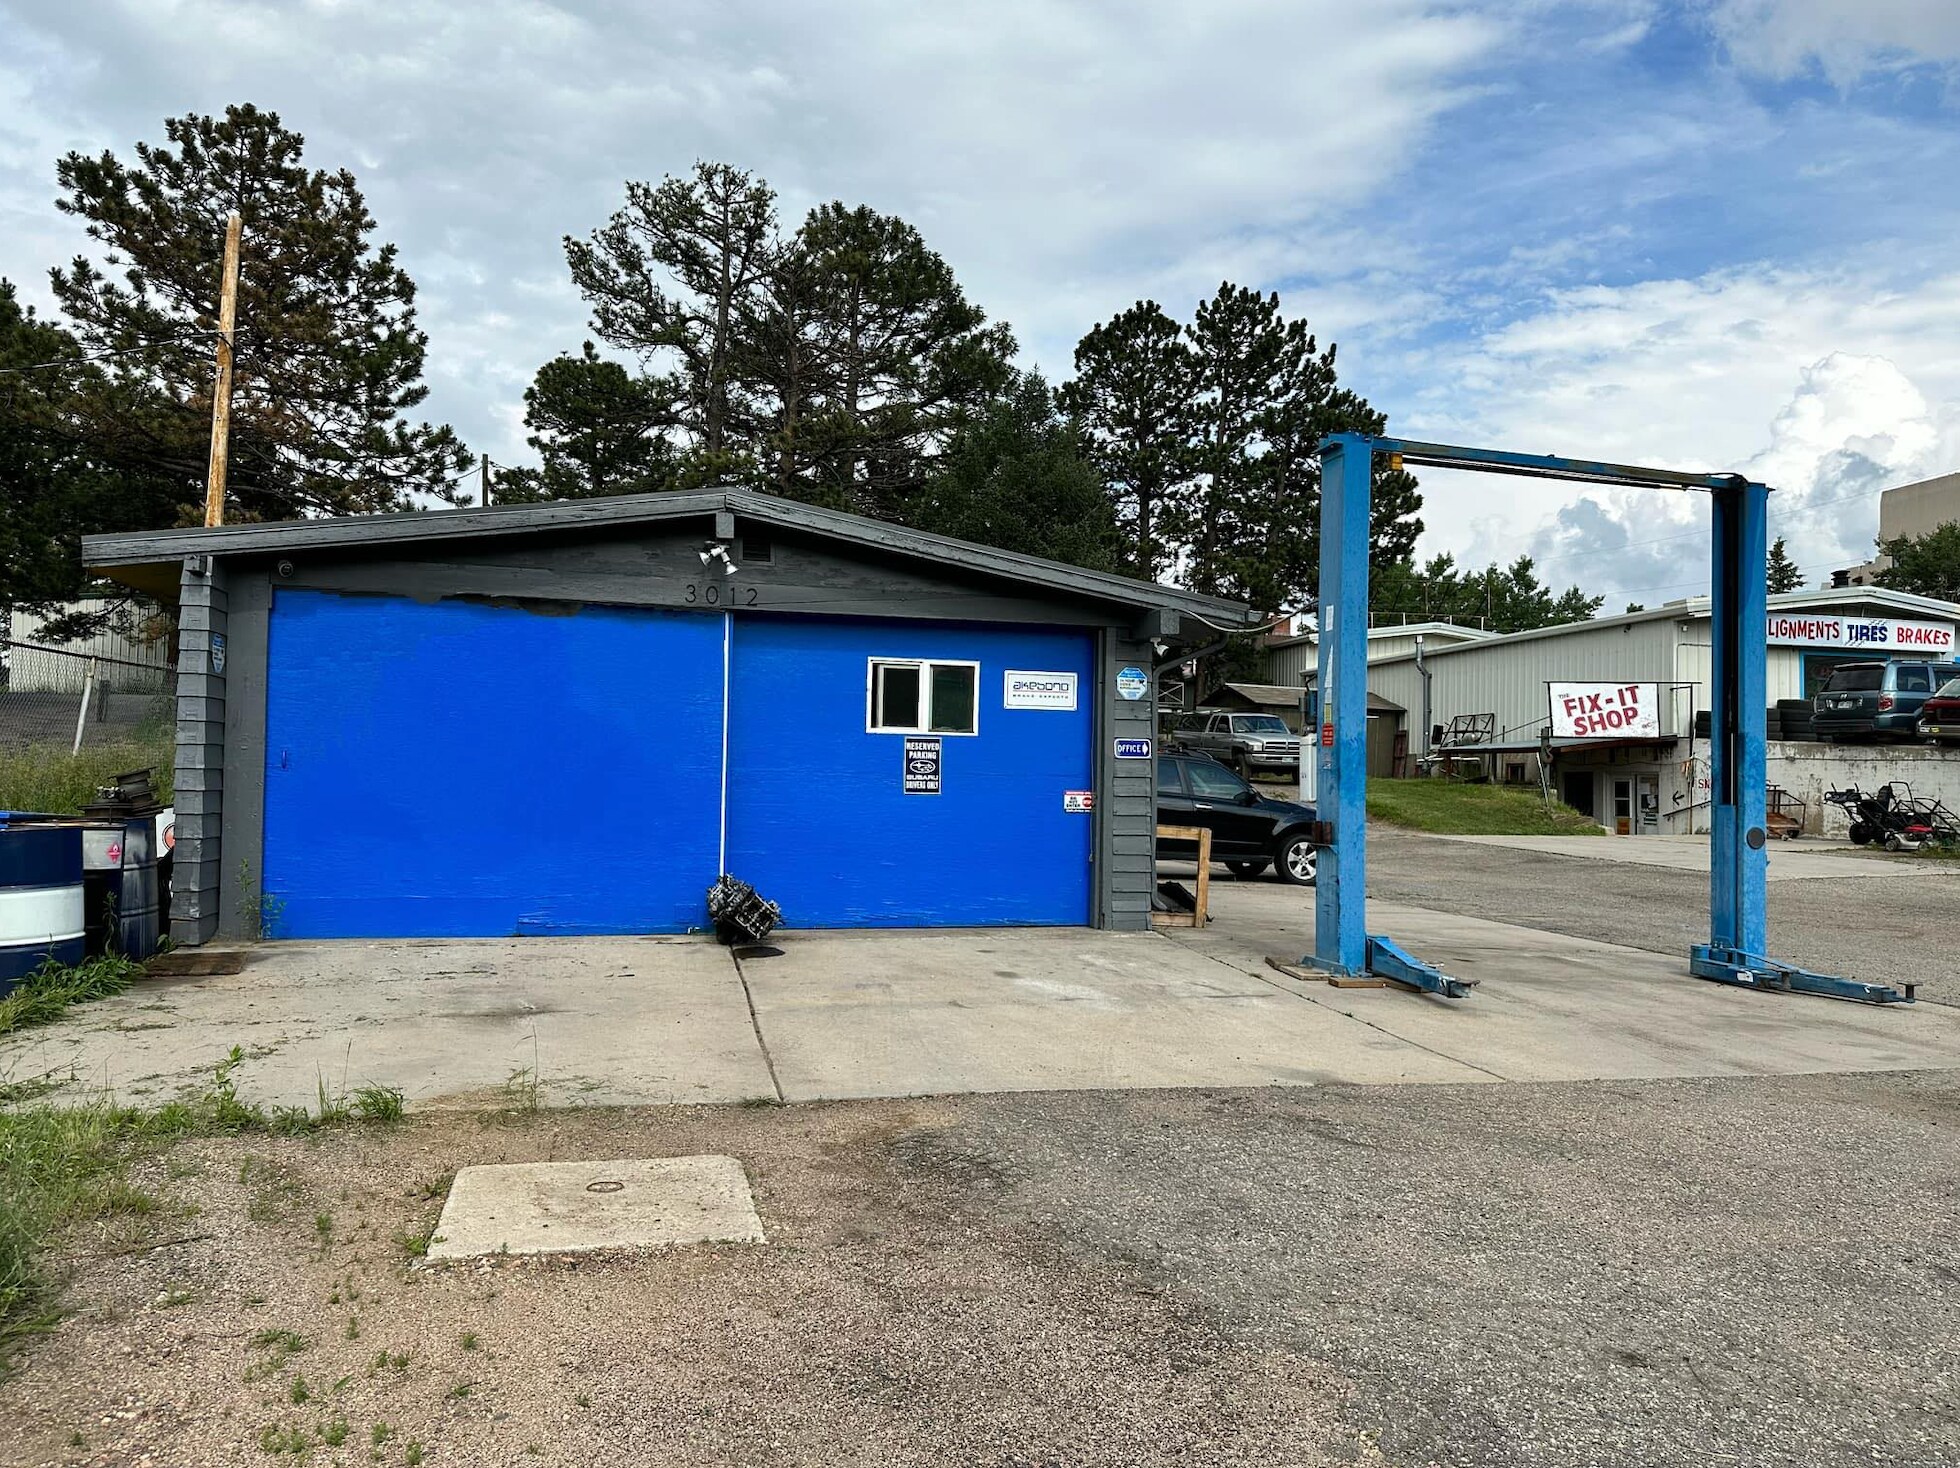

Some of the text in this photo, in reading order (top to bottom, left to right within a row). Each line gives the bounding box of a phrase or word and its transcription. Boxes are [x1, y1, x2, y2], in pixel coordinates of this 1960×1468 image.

[685, 584, 758, 607] 3012
[1768, 618, 1951, 645] LIGNMENTS TIRES BRAKES
[1573, 706, 1639, 736] SHOP
[906, 742, 940, 750] RESERVED
[1117, 744, 1142, 753] OFFICE
[908, 751, 937, 760] PARKING
[905, 780, 939, 790] DRIVERS ONLY
